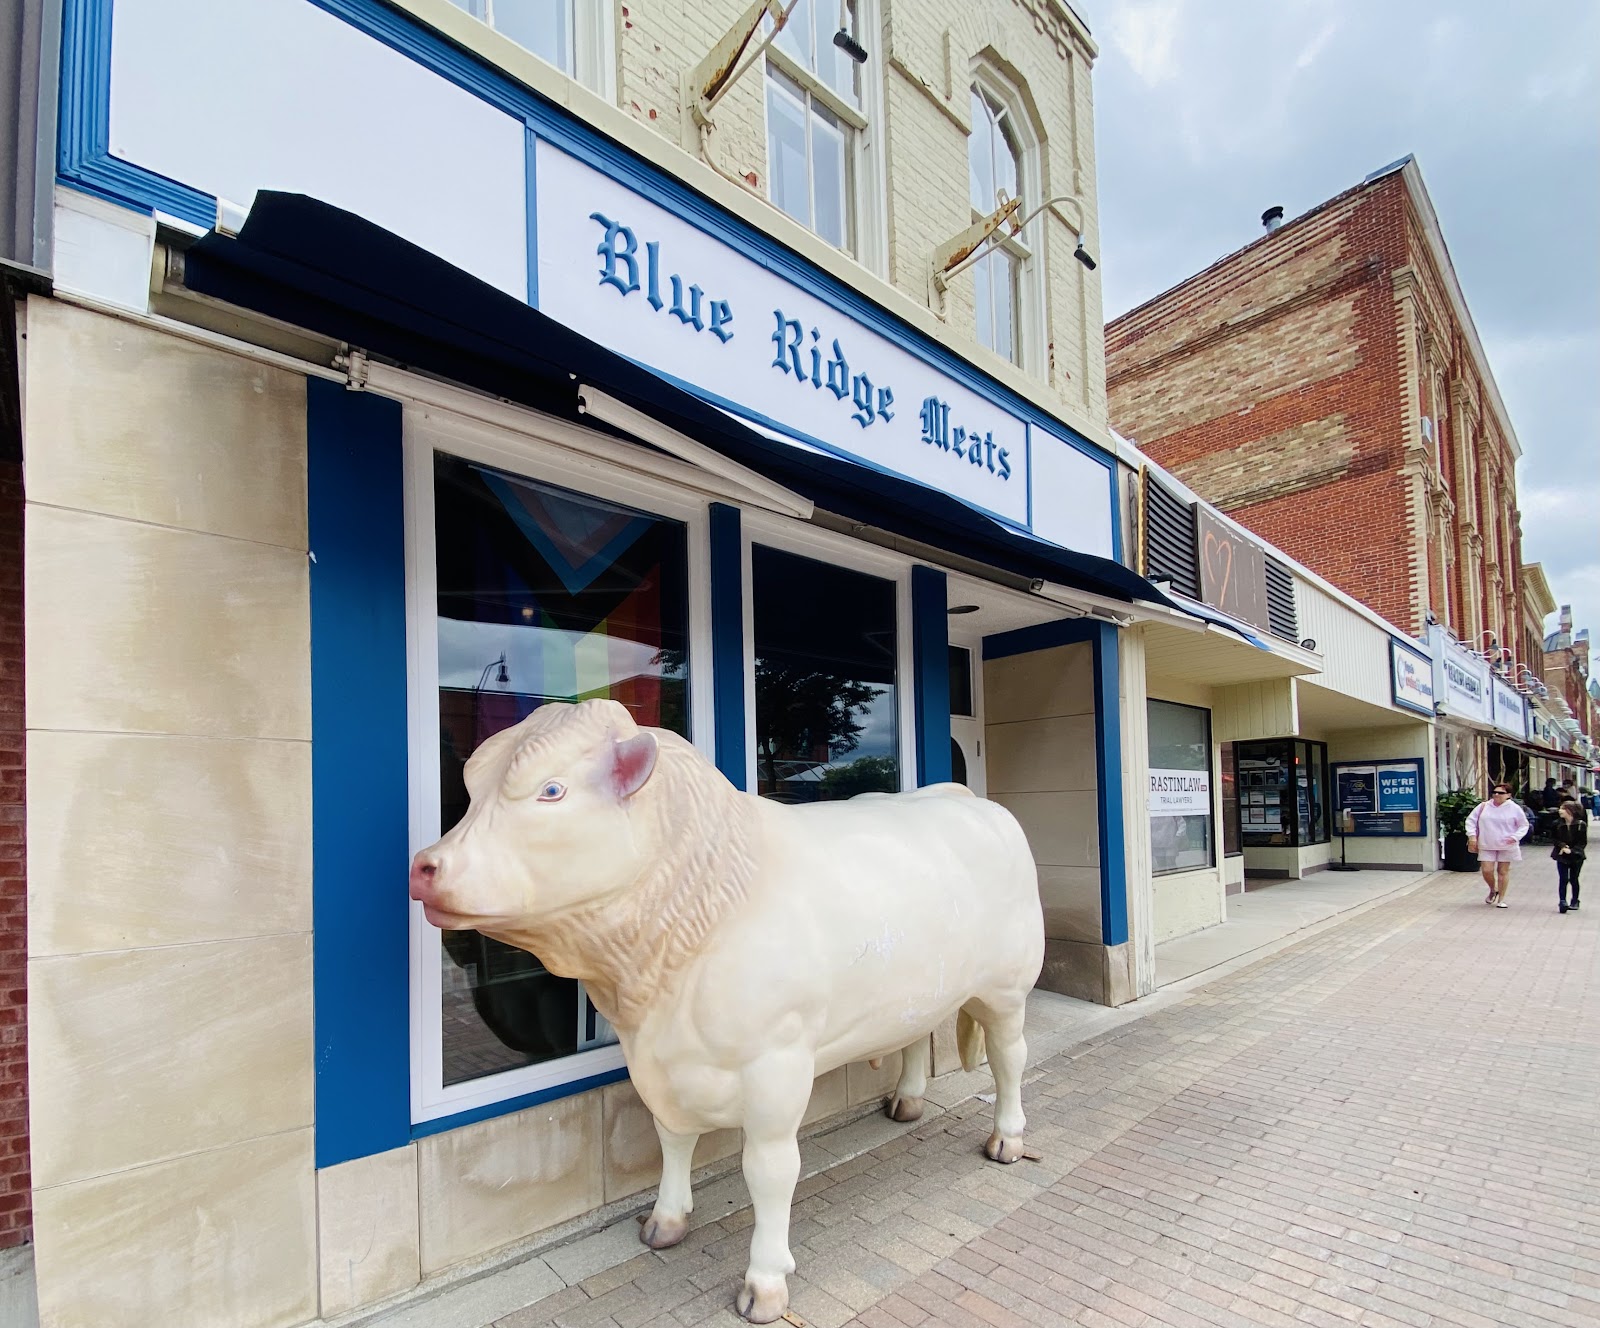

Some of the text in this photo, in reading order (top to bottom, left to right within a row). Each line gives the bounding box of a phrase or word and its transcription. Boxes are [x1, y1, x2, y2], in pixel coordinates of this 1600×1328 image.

[589, 211, 1012, 481] Blue Ridge Meats
[1151, 776, 1200, 791] RASTINLAW
[1380, 778, 1415, 787] WE'RE
[1383, 787, 1414, 795] OPEN
[1160, 796, 1193, 804] TRIAL LAWYERS
